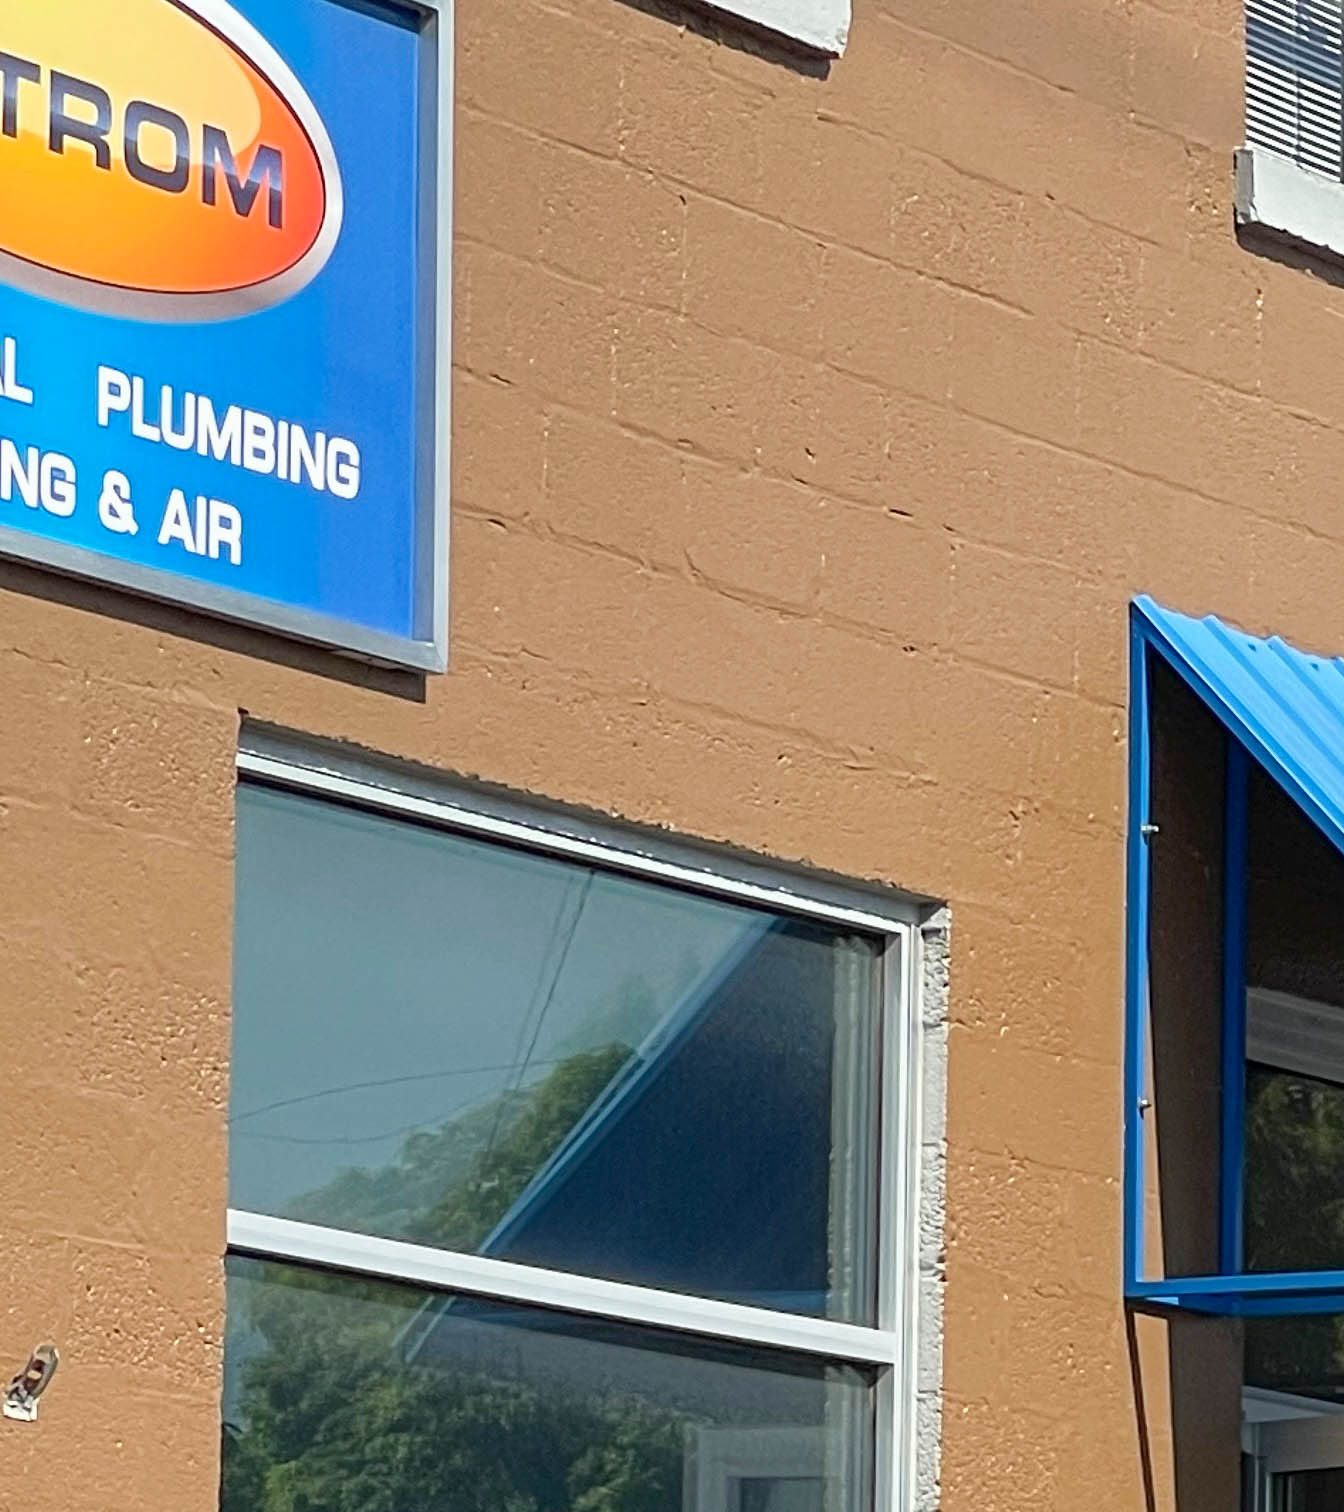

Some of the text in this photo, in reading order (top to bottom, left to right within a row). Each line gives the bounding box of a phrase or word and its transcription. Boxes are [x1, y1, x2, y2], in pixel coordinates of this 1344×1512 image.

[0, 336, 360, 500] L PLUMBING
[99, 469, 138, 535] &
[157, 489, 242, 565] AIR
